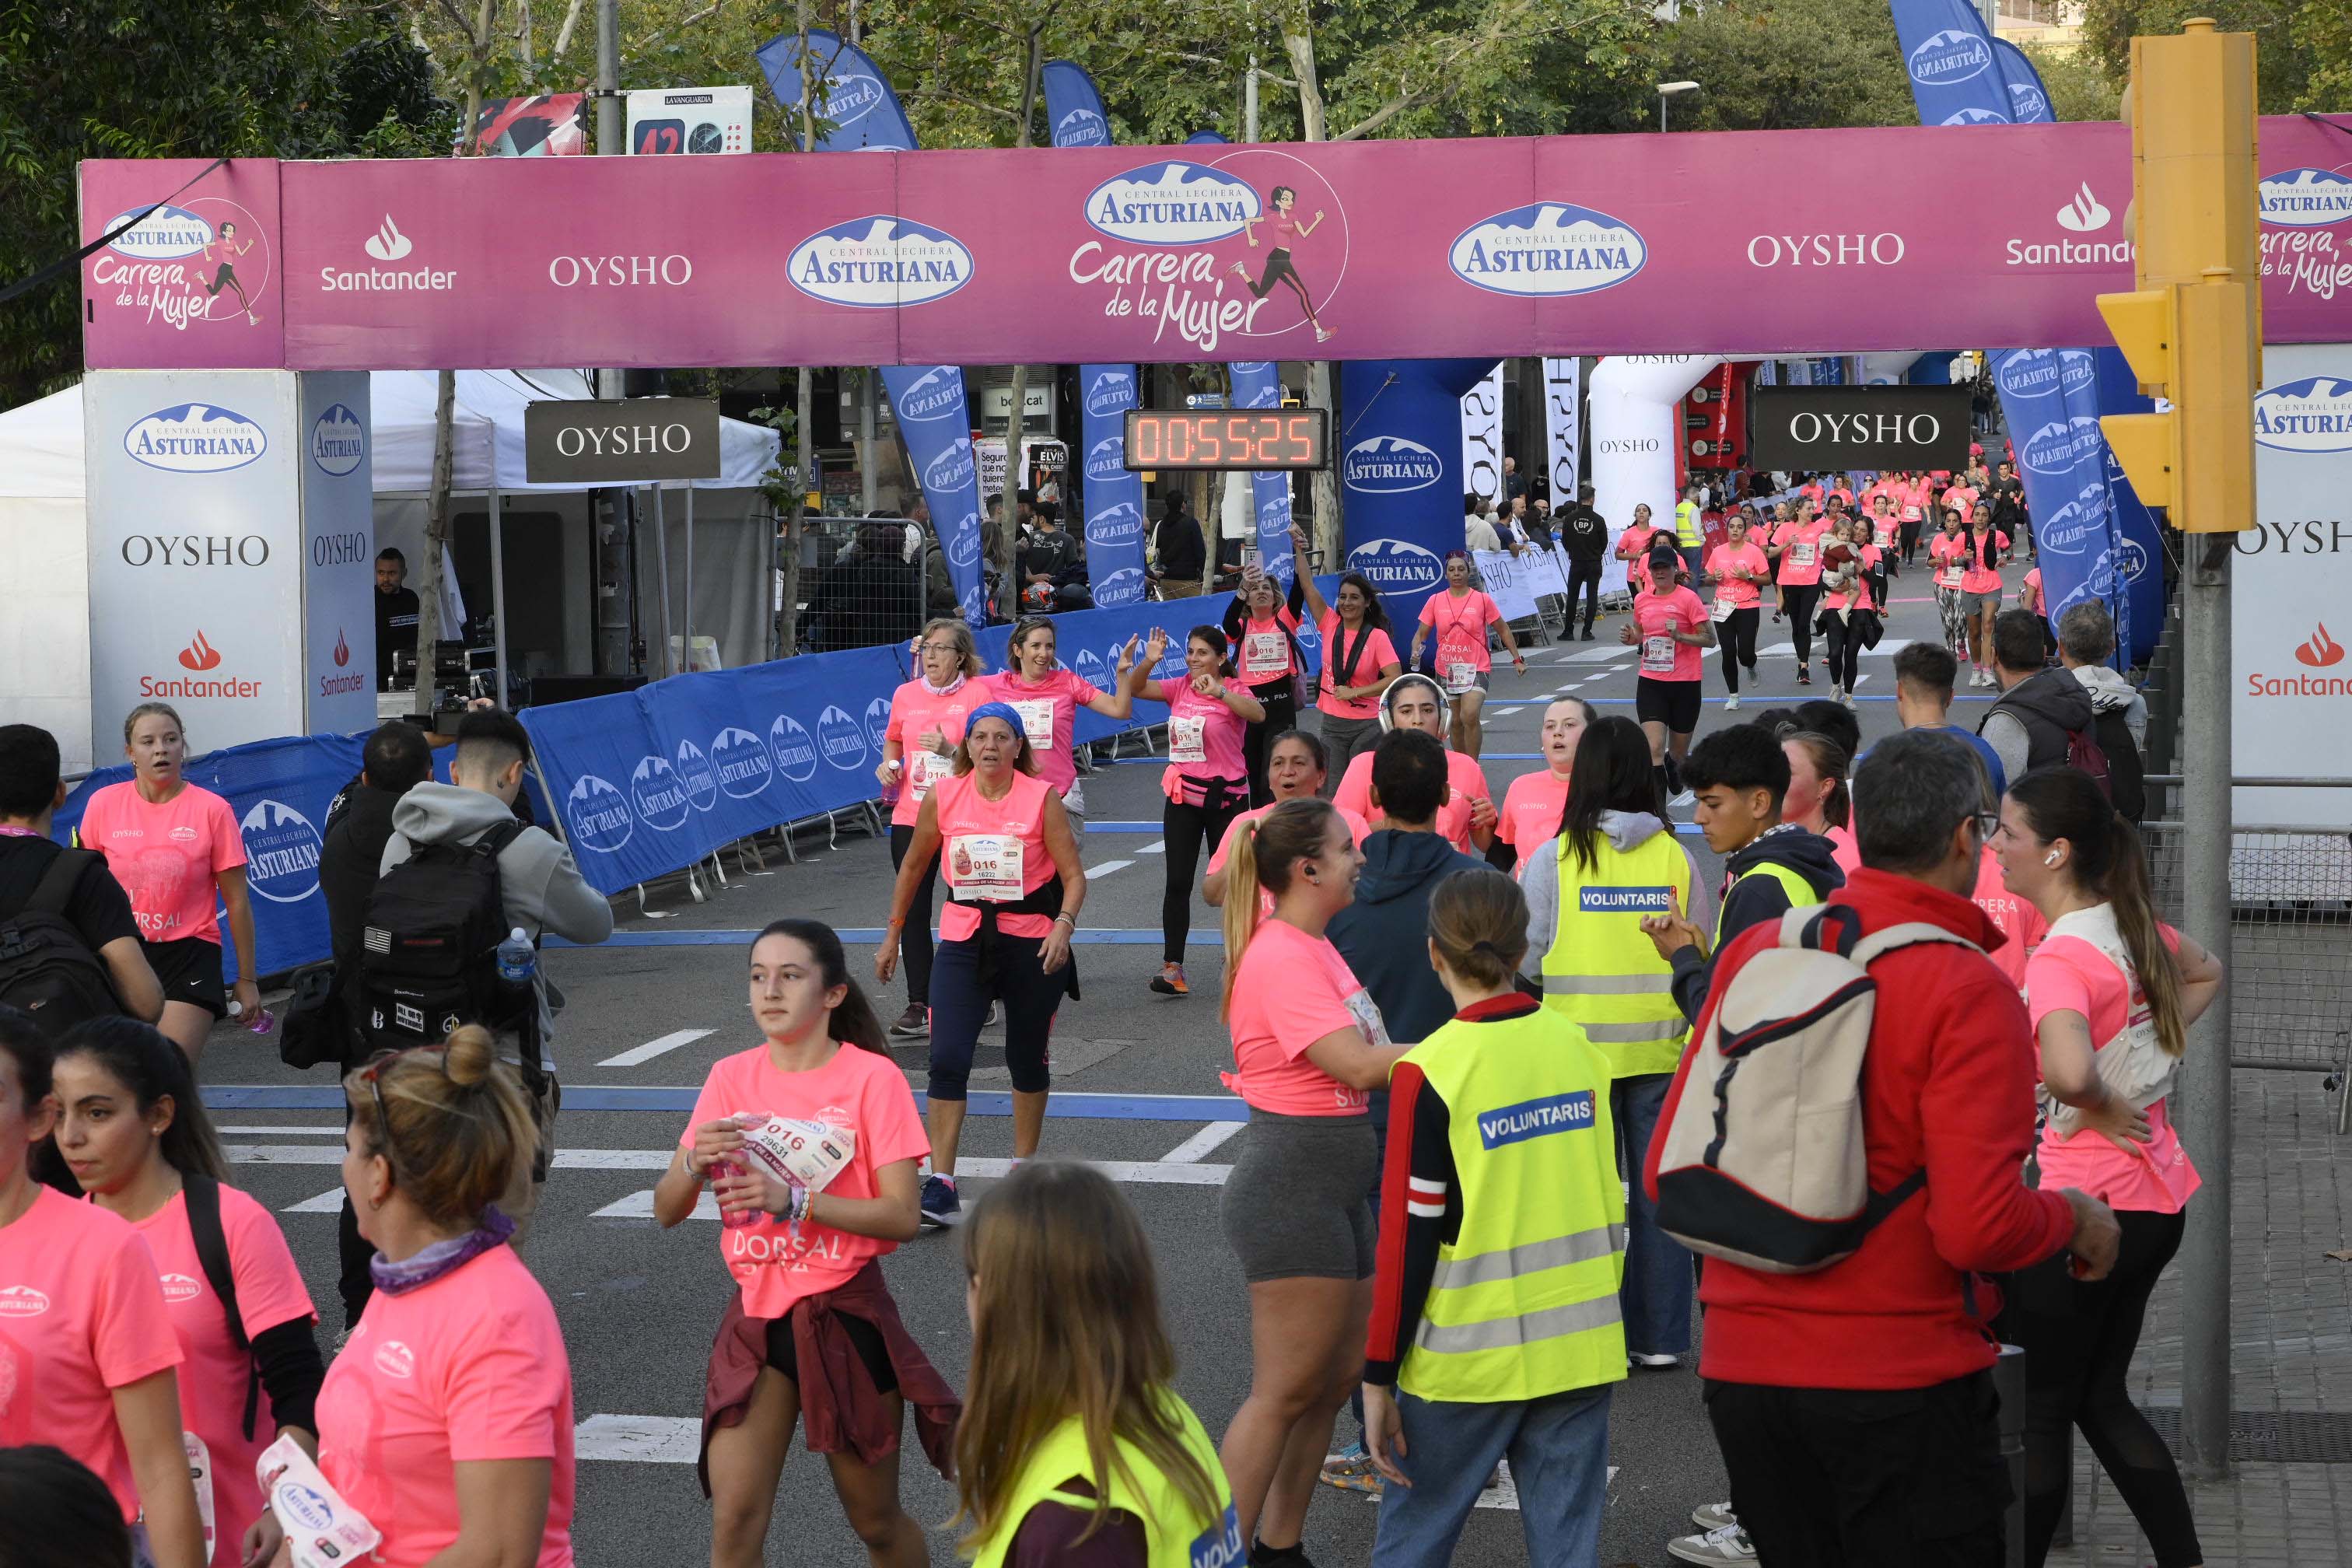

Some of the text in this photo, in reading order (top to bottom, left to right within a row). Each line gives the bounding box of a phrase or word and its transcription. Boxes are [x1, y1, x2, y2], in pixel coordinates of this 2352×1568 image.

[673, 95, 712, 104] VANGUARDIA
[1124, 188, 1242, 199] CENTRAL LECHERA
[1097, 193, 1247, 225] ASTURIANA
[1494, 233, 1626, 245] CENTRAL LECHERA
[1747, 232, 1906, 268] OYSHO
[2259, 230, 2334, 254] arrera
[829, 246, 954, 257] CENTRAL LECHERA
[1069, 240, 1215, 285] Carrera
[1463, 237, 1632, 274] ASTURIANA
[93, 255, 185, 285] Carrera
[549, 254, 693, 287] OYSHO
[800, 250, 960, 284] ASTURIANA
[2277, 254, 2292, 275] la
[320, 265, 457, 292] Santander
[116, 282, 220, 331] de la Mujer
[1104, 278, 1269, 352] de la Mujer
[156, 426, 252, 436] CENTRAL LECHERA
[555, 423, 692, 457] OYSHO
[1137, 418, 1311, 461] 00:55:25
[1789, 411, 1941, 445] OYSHO
[135, 429, 257, 456] ASTURIANA
[315, 430, 362, 458] ASTURIANA
[1599, 437, 1660, 454] OYSHO
[982, 464, 996, 473] que
[1040, 451, 1064, 462] ELVIS
[982, 473, 1008, 484] quiere
[1346, 457, 1436, 481] ASTURIANA
[1578, 520, 1590, 529] BP
[121, 535, 270, 568] OYSHO
[313, 531, 366, 567] OYSHO
[1363, 566, 1436, 581] TURIANA
[1440, 653, 1465, 663] SUMA
[1441, 643, 1472, 653] DORSAL
[140, 676, 262, 698] Santander
[320, 671, 364, 697] Santander
[2248, 673, 2352, 697] Santan
[1274, 692, 1288, 701] FILA
[778, 744, 815, 768] ASTURIANA
[823, 732, 865, 757] ASTURIANA
[716, 754, 771, 785] ASTURIANA
[112, 830, 144, 839] OYSHO
[253, 829, 312, 849] CENTRAL LECHERA
[246, 842, 320, 882] ASTURIANA
[974, 860, 998, 870] 016
[1582, 893, 1669, 906] VOLUNTARIS
[1978, 898, 2018, 913] RERA
[135, 911, 182, 931] RSAL
[397, 1015, 423, 1031] NOTHING
[1482, 1100, 1591, 1139] VOLUNTARIS
[760, 1135, 789, 1160] 29631
[767, 1125, 806, 1151] 016
[755, 1145, 766, 1156] DE
[764, 1155, 773, 1165] LA
[771, 1159, 793, 1182] MUJER
[733, 1230, 841, 1261] DORSAL
